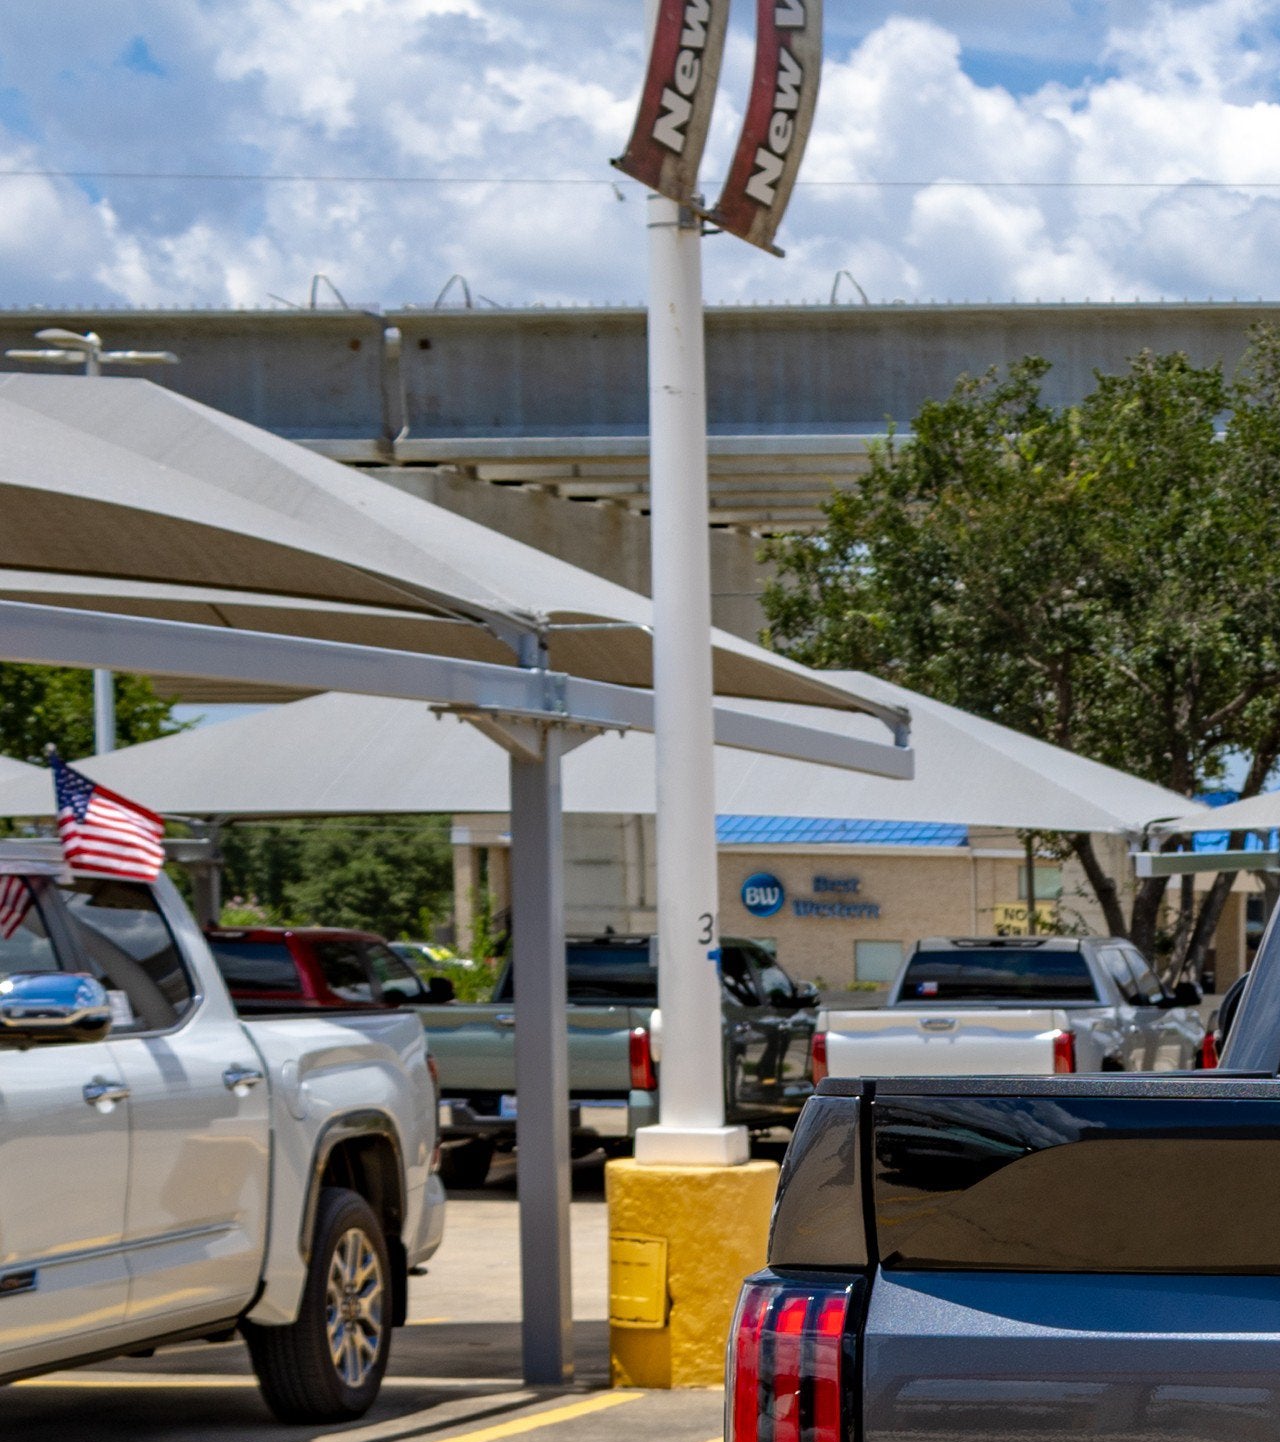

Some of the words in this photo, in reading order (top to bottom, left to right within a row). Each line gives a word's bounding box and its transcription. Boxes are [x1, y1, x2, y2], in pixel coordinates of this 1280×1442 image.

[652, 0, 711, 153] New
[745, 46, 803, 207] New
[698, 913, 713, 945] 3
[745, 887, 780, 906] BW
